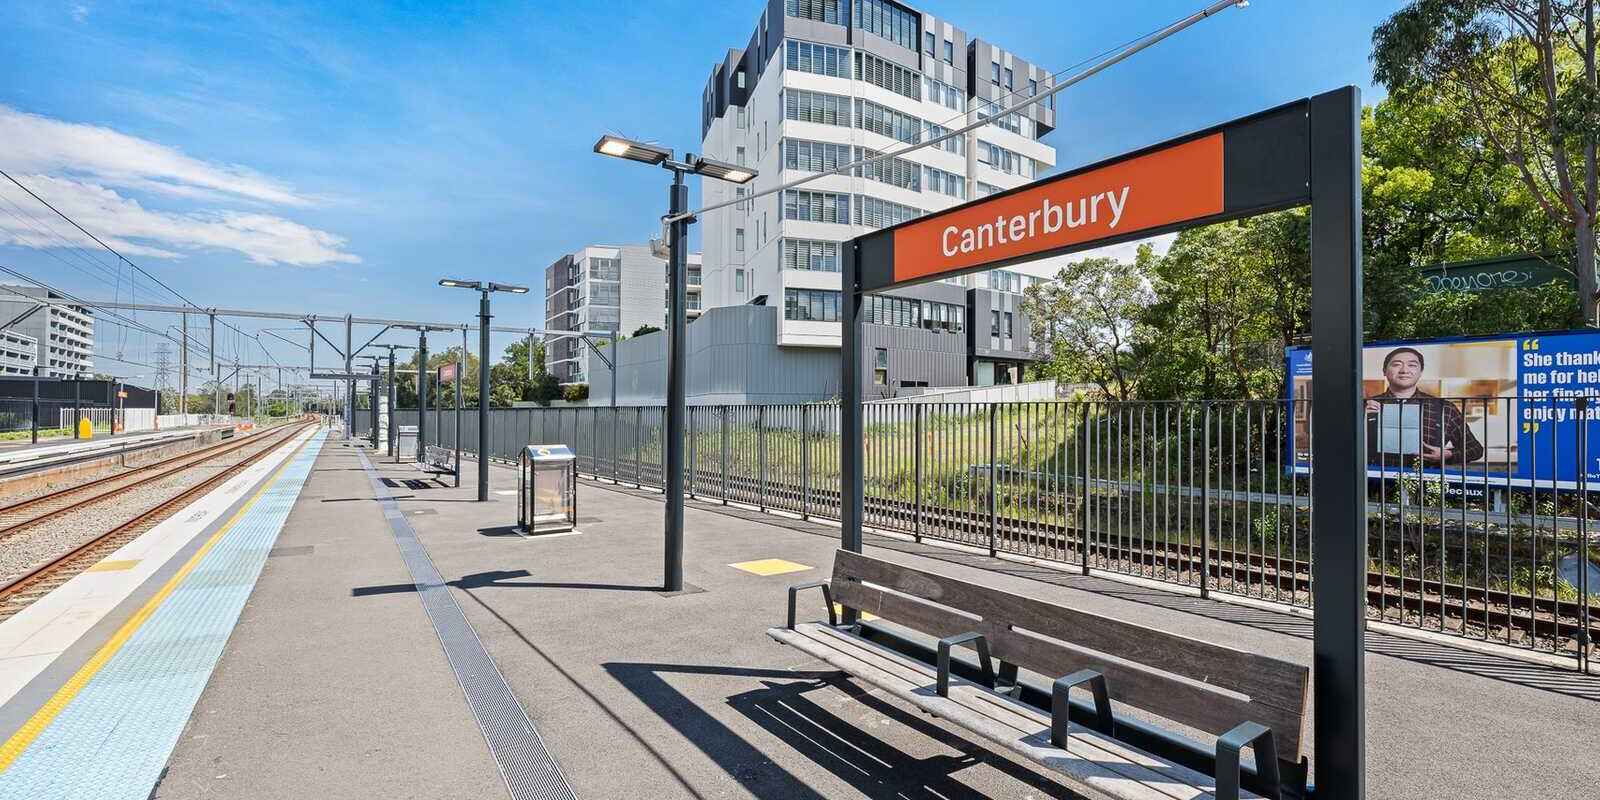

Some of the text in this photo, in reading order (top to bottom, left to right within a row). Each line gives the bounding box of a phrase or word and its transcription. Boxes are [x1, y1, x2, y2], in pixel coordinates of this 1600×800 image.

[942, 186, 1130, 257] Canterbury
[1523, 353, 1552, 367] She
[1523, 372, 1547, 384] me
[1550, 370, 1574, 384] for
[1523, 388, 1549, 402] her
